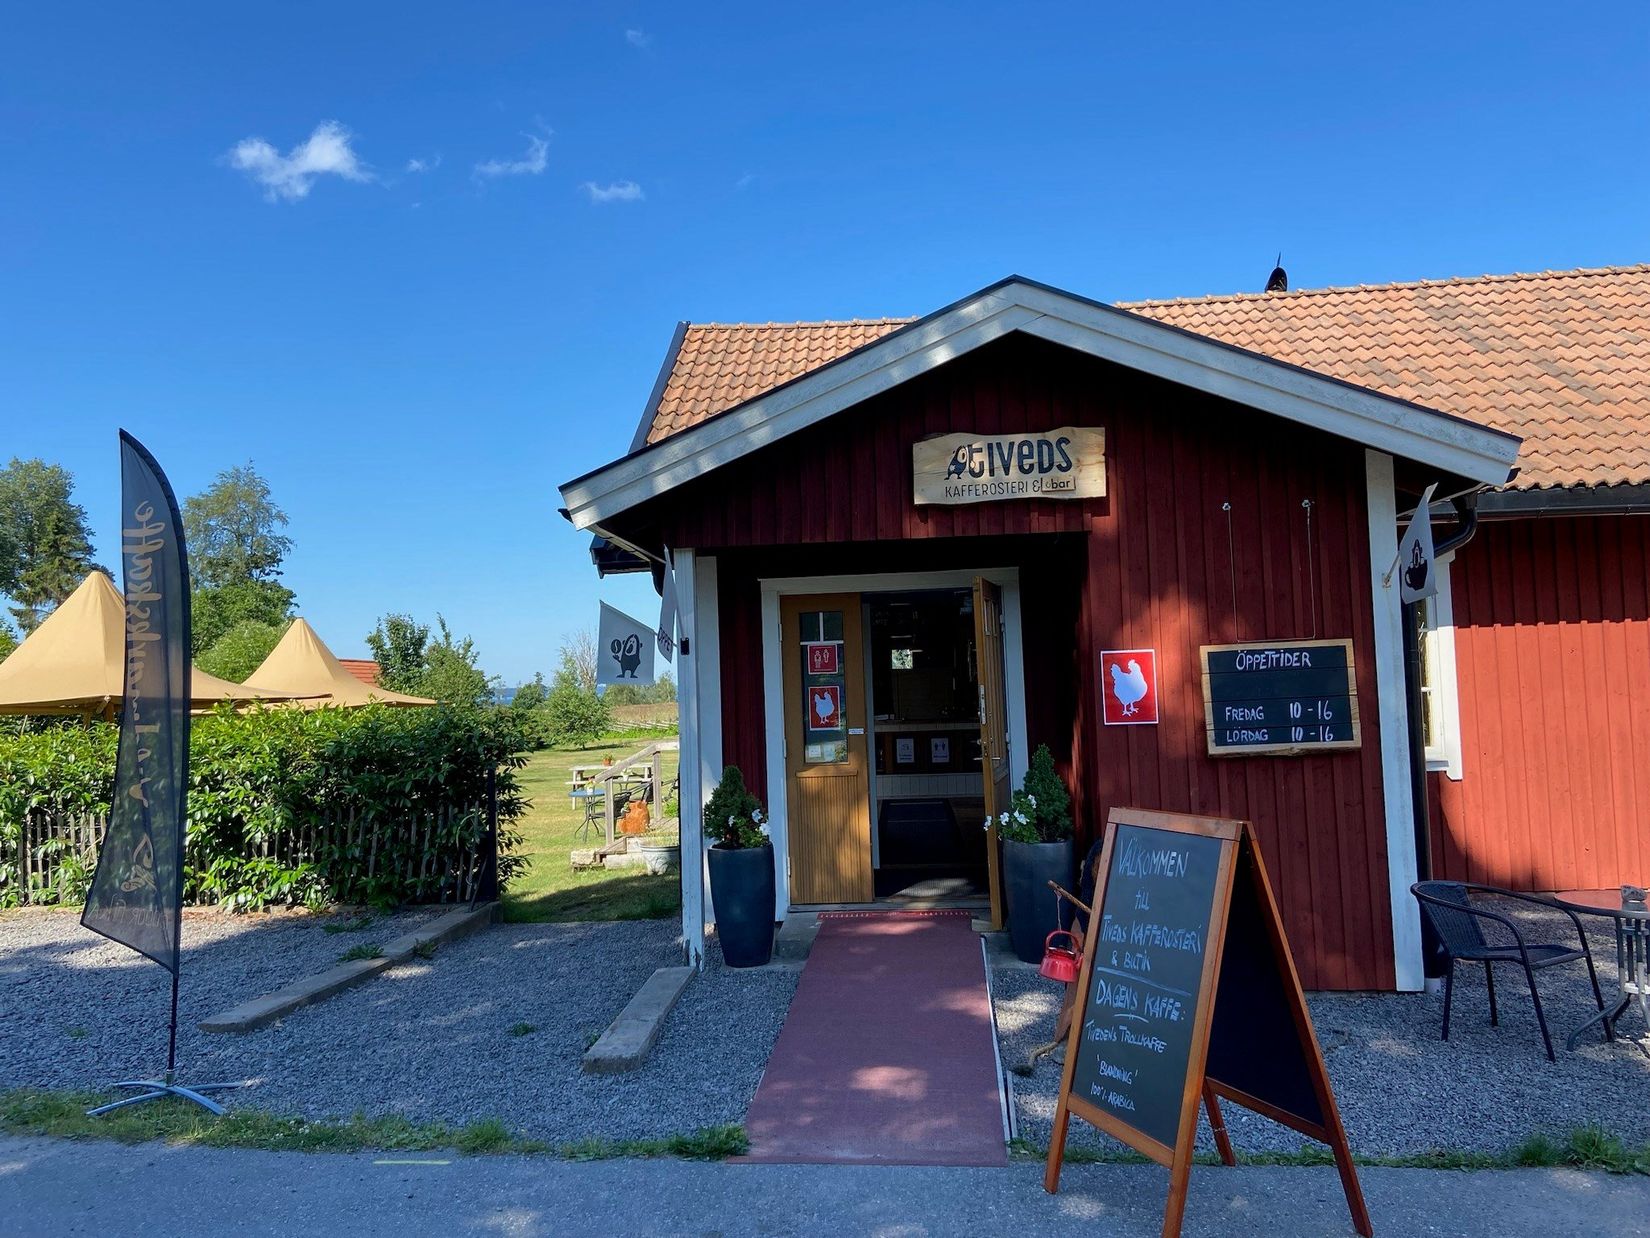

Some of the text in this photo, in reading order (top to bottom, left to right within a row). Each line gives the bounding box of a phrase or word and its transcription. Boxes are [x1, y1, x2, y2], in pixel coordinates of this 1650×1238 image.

[945, 481, 1028, 498] KAFFEROSTERI
[1032, 480, 1041, 492] &
[1236, 650, 1311, 670] ÖPPETTIDER
[1225, 706, 1265, 721] FREDAG
[1289, 702, 1302, 719] 10
[1318, 700, 1333, 720] 16
[1291, 727, 1303, 742] 10
[1319, 726, 1333, 742] 16
[1119, 836, 1190, 878] VÄLKOMMEN
[1111, 950, 1118, 967] &
[1096, 979, 1138, 1010] DAGENS
